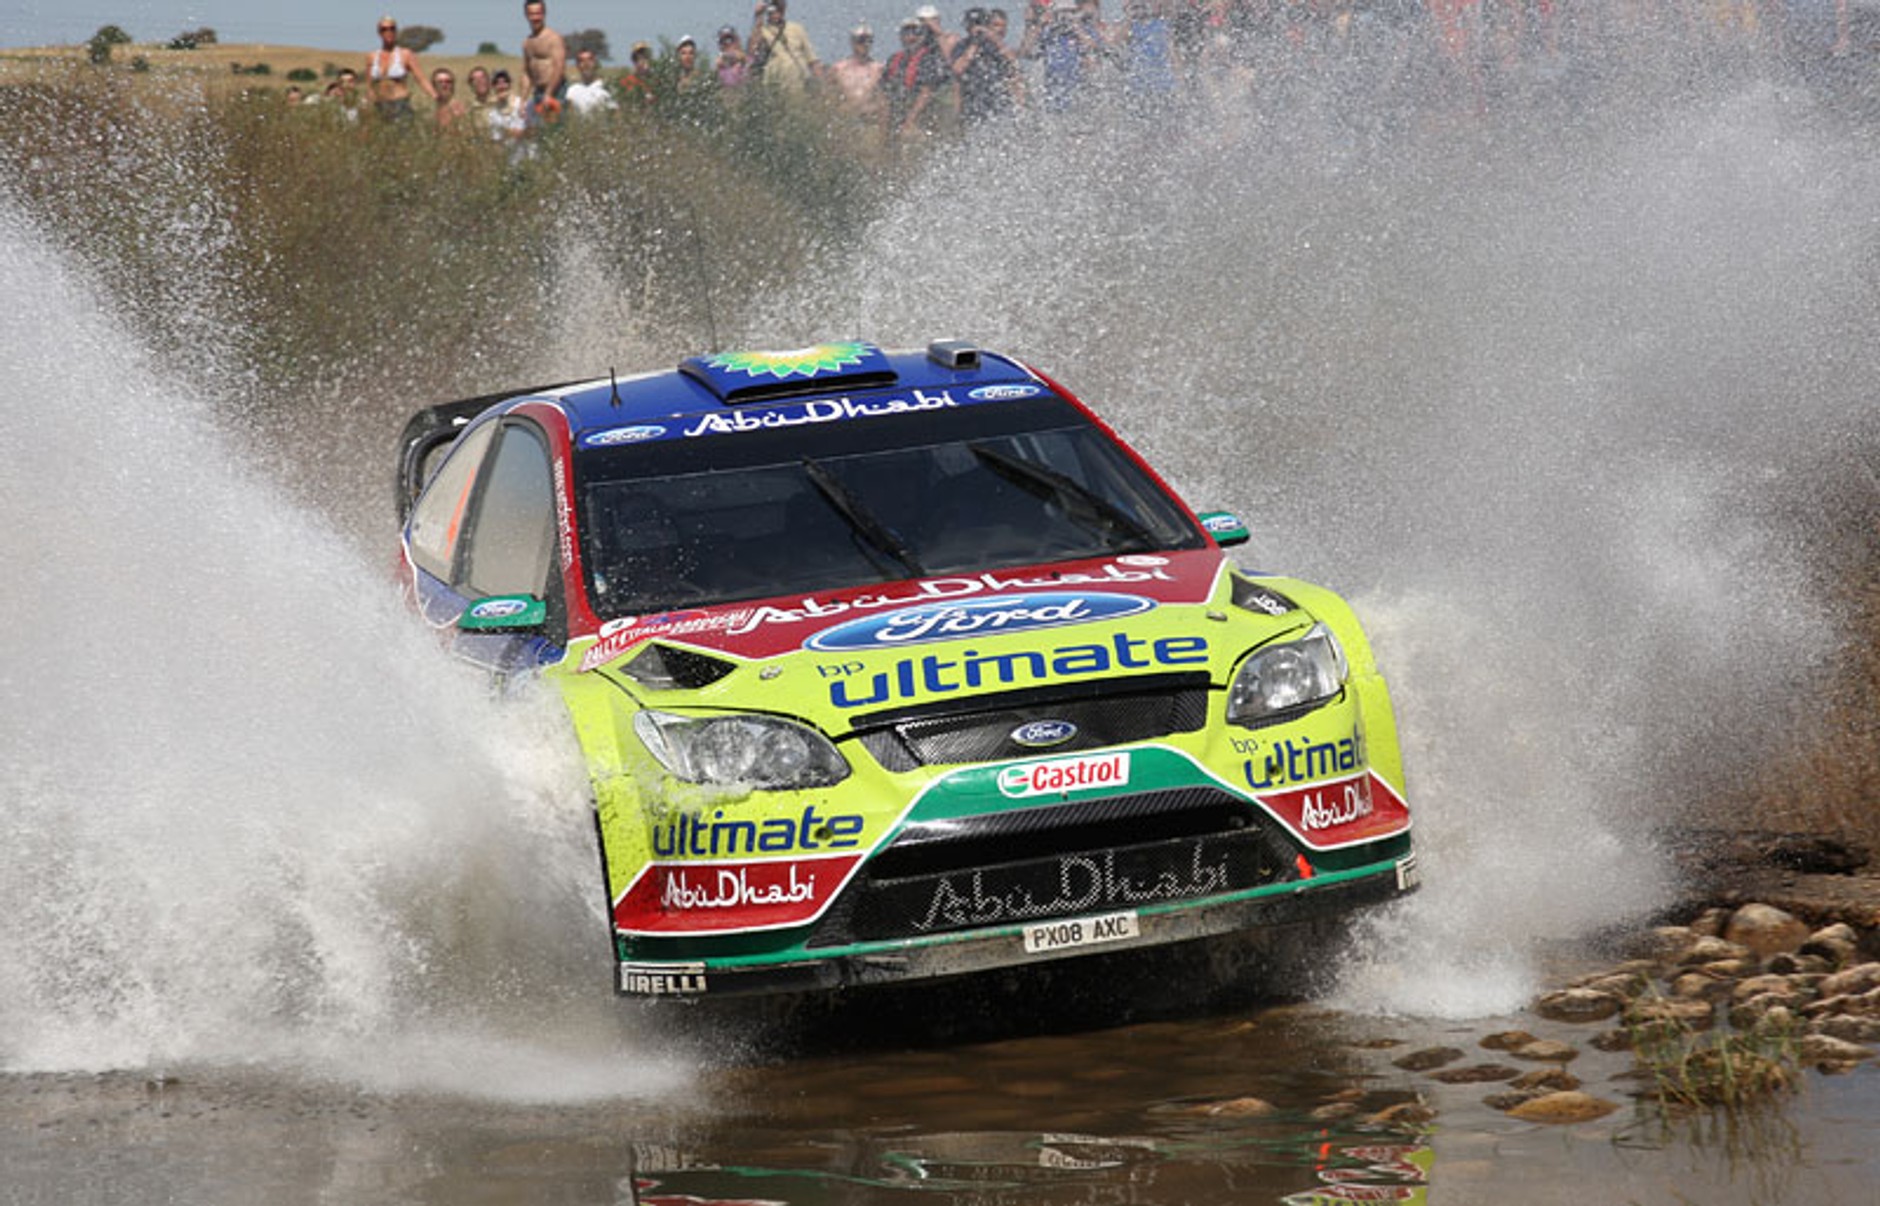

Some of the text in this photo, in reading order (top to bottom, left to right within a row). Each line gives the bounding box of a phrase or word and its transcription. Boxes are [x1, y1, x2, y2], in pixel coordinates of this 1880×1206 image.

[875, 598, 1091, 642] Ford
[816, 659, 864, 679] bp
[829, 632, 1209, 709] ultimate
[1230, 737, 1258, 755] bp
[1032, 757, 1121, 791] Castrol
[653, 806, 863, 856] ultimate
[1033, 916, 1129, 948] PX08 AXC
[621, 961, 707, 993] PIRELLI
